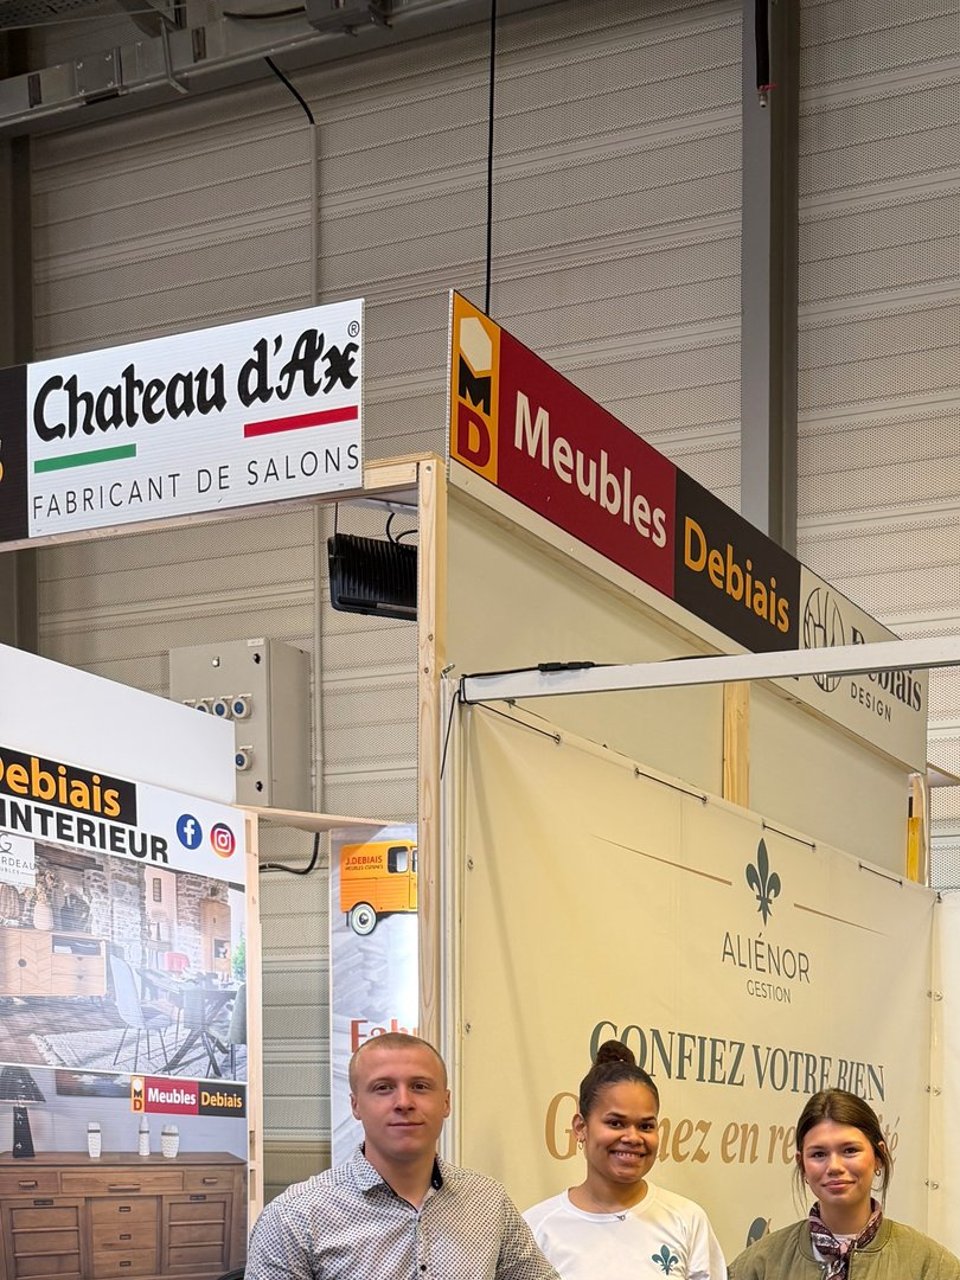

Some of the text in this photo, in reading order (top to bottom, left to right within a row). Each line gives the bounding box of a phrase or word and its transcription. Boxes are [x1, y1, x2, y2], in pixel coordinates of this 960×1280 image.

[33, 328, 360, 442] Chateau d'Ax
[33, 443, 359, 520] FABRICANT DE SALONS
[513, 390, 790, 634] Meubles Debiais
[850, 682, 892, 723] DESIGN
[721, 931, 811, 984] ALIÉNOR
[746, 979, 792, 1004] GESTION
[589, 1020, 886, 1103] CONFIEZ VOTRE BIEN
[147, 1087, 243, 1109] Meubles Debiais
[720, 1118, 760, 1164] en
